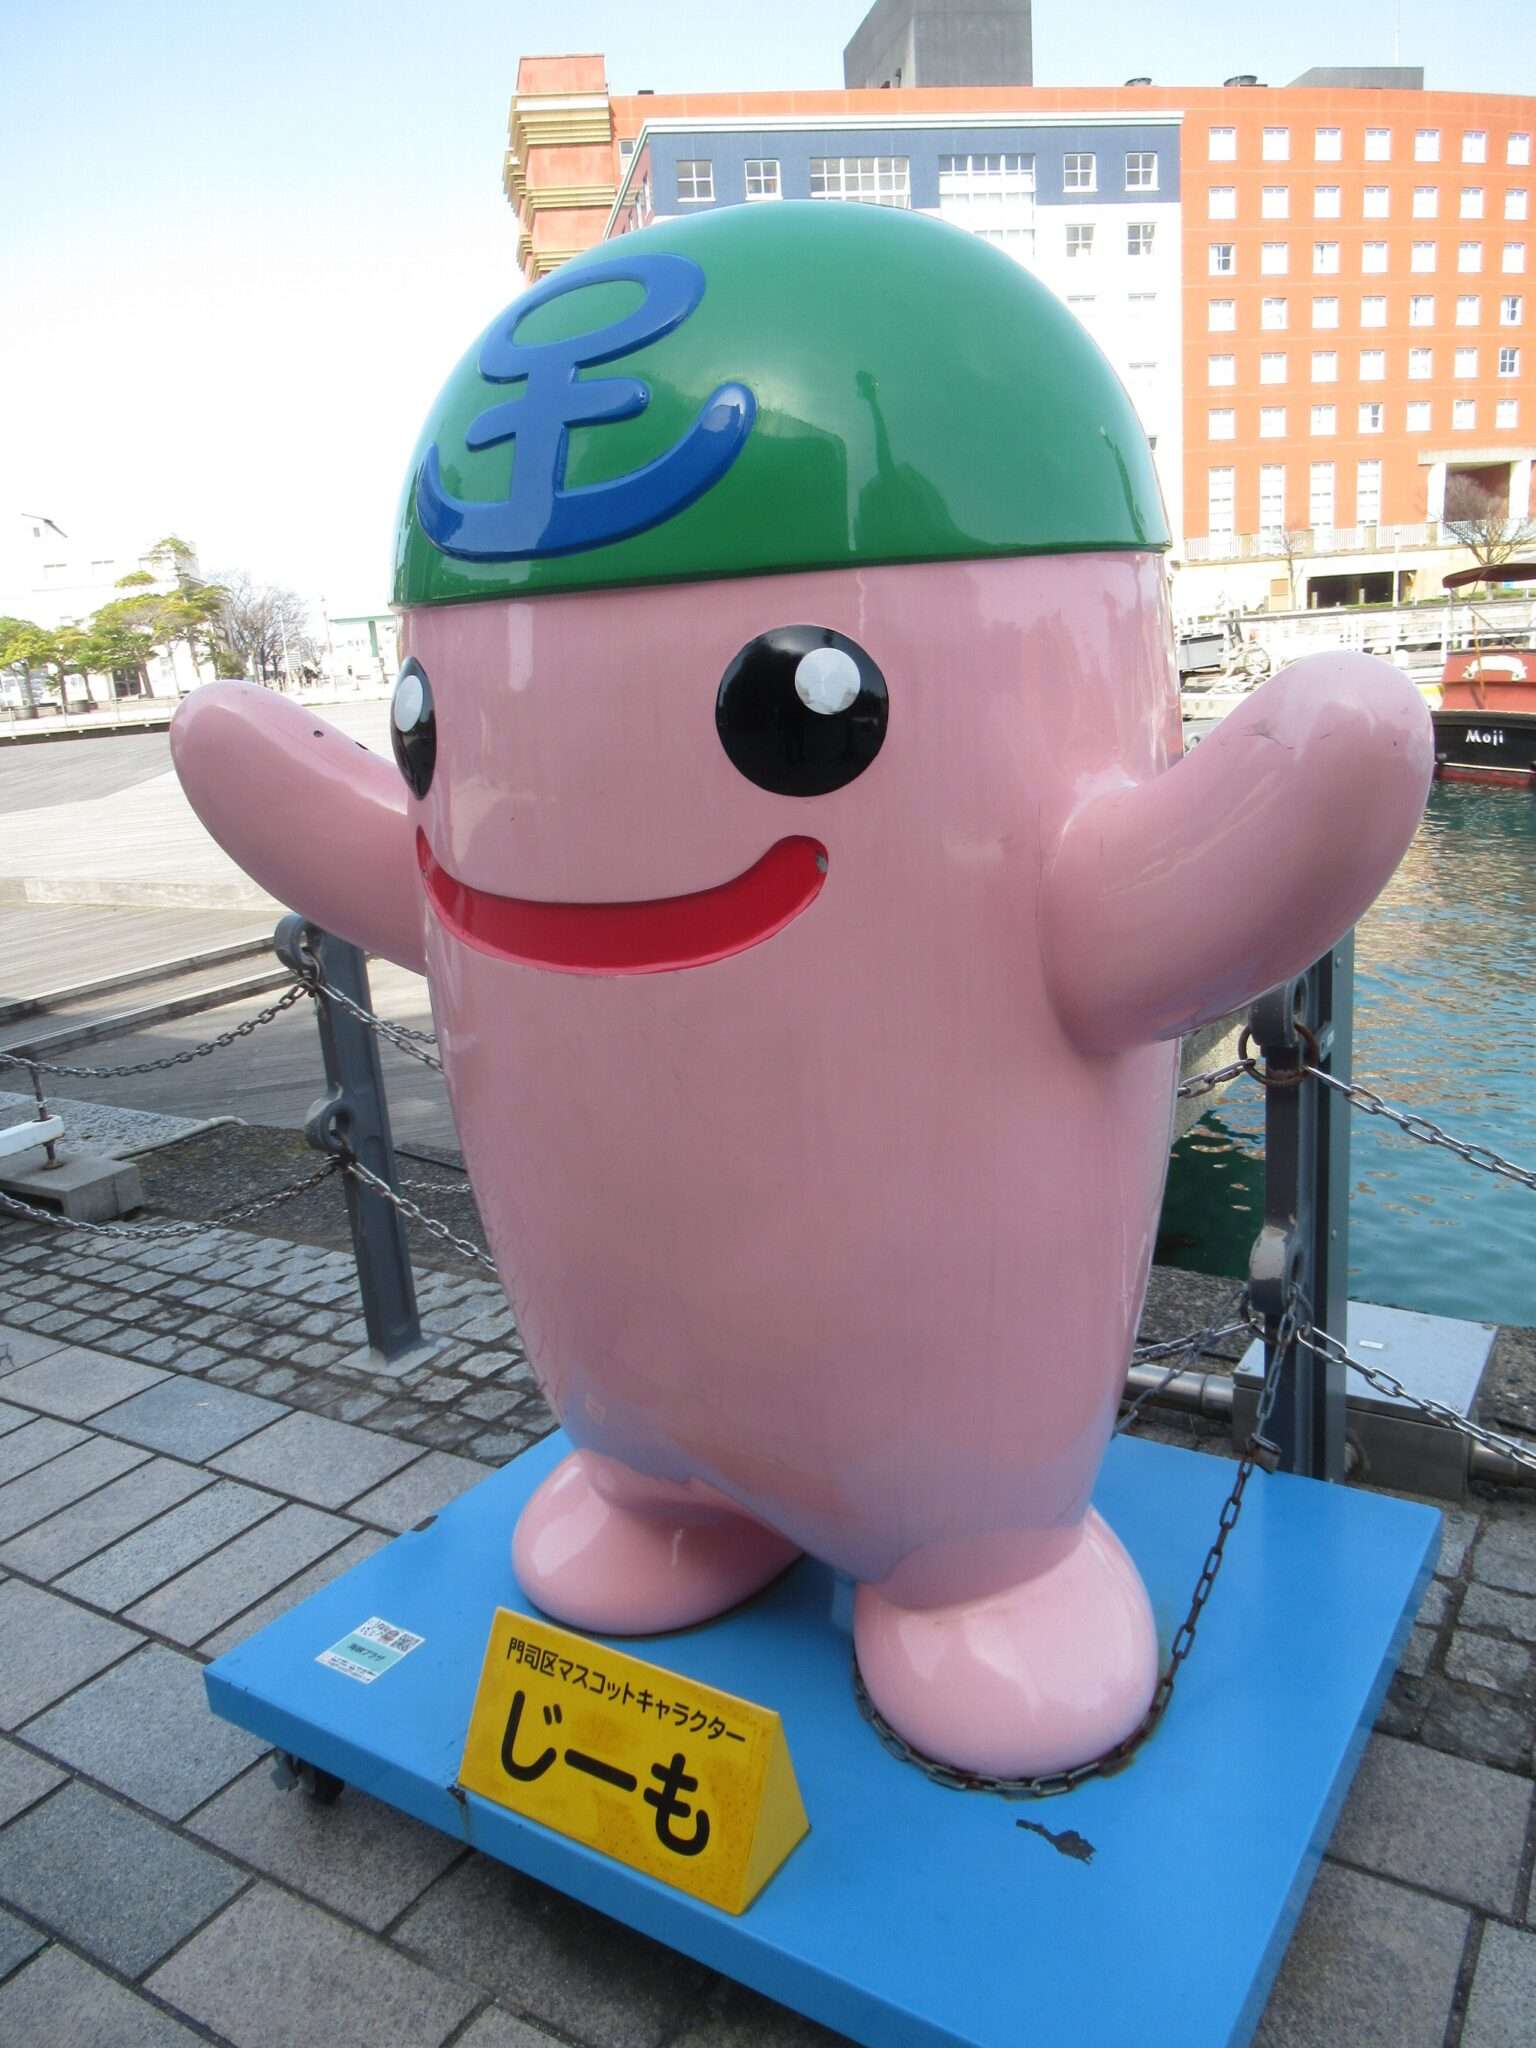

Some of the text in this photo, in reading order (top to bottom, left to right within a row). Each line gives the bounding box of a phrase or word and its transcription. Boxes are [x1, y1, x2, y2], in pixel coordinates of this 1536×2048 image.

[1465, 730, 1504, 746] Moji
[506, 1637, 746, 1743] 門司区マスコットキャラクター
[501, 1690, 711, 1857] じーも
